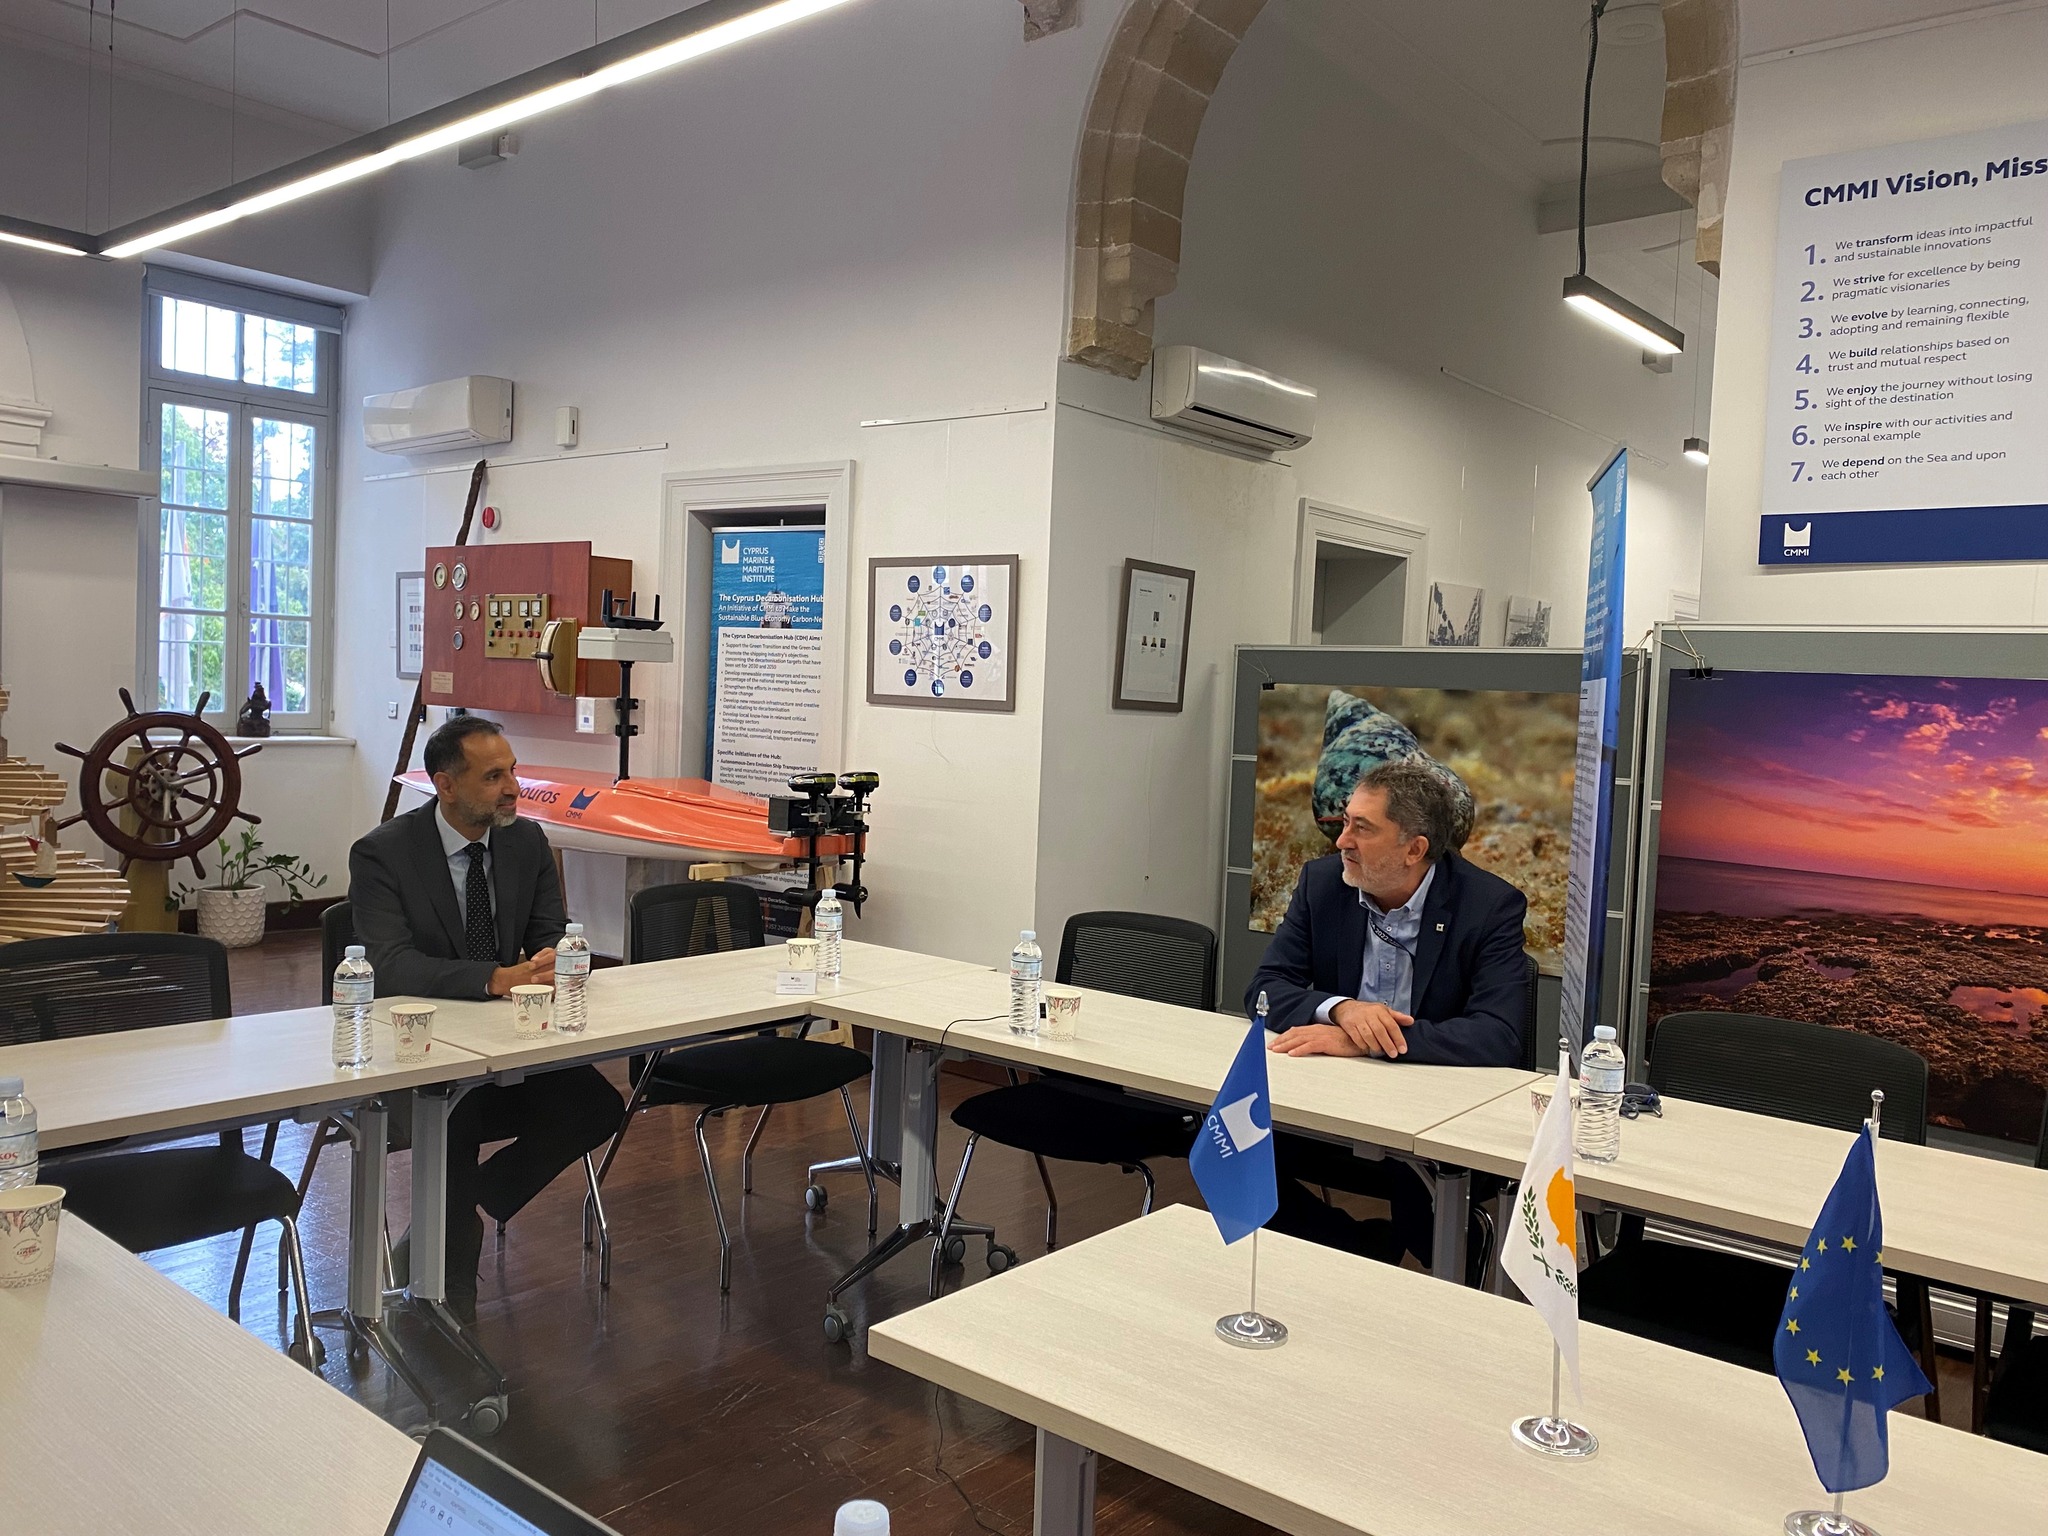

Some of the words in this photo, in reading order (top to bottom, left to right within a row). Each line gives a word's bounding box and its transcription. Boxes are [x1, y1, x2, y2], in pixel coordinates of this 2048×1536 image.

[1804, 179, 1878, 207] CMMI
[1886, 169, 1978, 195] Vision,
[1985, 156, 2048, 182] Miss
[1836, 241, 1853, 250] We
[1856, 233, 1913, 248] transform
[1916, 228, 1946, 240] ideas
[1949, 225, 1972, 236] into
[1975, 216, 2033, 233] impactful
[1804, 244, 1826, 265] 1.
[1834, 252, 1854, 262] and
[1858, 244, 1920, 260] sustainable
[1924, 236, 1991, 251] innovations
[1833, 277, 1850, 286] We
[1853, 273, 1885, 285] strive
[1888, 271, 1904, 281] for
[1907, 263, 1967, 279] excellence
[1970, 260, 1984, 273] by
[1987, 257, 2021, 271] being
[1800, 281, 1824, 302] 2.
[1832, 286, 1887, 300] pragmatic
[1891, 278, 1950, 292] visionaries
[1831, 314, 1848, 324] We
[1851, 310, 1888, 322] evolve
[1891, 308, 1904, 319] by
[1908, 302, 1957, 316] learning,
[1959, 295, 2029, 311] connecting,
[1798, 317, 1821, 338] 3.
[1830, 323, 1878, 337] adopting
[1881, 320, 1902, 331] and
[1906, 314, 1963, 328] remaining
[1966, 310, 2009, 322] flexible
[1829, 350, 1846, 360] We
[1850, 348, 1877, 358] build
[1880, 340, 1953, 356] relationships
[1956, 336, 1991, 348] based
[1995, 336, 2009, 344] on
[1796, 354, 1819, 374] 4.
[1828, 362, 1854, 372] trust
[1857, 359, 1877, 370] and
[1880, 356, 1921, 368] mutual
[1924, 352, 1967, 366] respect
[1827, 387, 1844, 396] We
[1847, 384, 1877, 398] enjoy
[1880, 382, 1899, 392] the
[1900, 379, 1944, 392] journey
[1947, 374, 1993, 386] without
[1997, 372, 2032, 386] losing
[1795, 389, 1817, 410] 5.
[1825, 399, 1852, 410] sight
[1855, 396, 1866, 406] of
[1869, 395, 1887, 405] the
[1890, 391, 1953, 403] destination
[1824, 423, 1841, 432] We
[1844, 420, 1882, 433] inspire
[1885, 419, 1909, 428] with
[1913, 418, 1932, 427] our
[1935, 413, 1987, 425] activities
[1990, 411, 2012, 421] and
[1792, 425, 1815, 445] 6.
[1823, 433, 1870, 446] personal
[1873, 430, 1921, 442] example
[1822, 459, 1839, 468] We
[1842, 456, 1884, 470] depend
[1888, 456, 1902, 464] on
[1905, 454, 1923, 463] the
[1927, 453, 1947, 462] Sea
[1950, 451, 1972, 461] and
[1976, 450, 2006, 462] upon
[1791, 462, 1813, 482] 7.
[1821, 470, 1846, 480] each
[1849, 469, 1879, 479] other
[732, 594, 754, 604] Cyprus
[520, 784, 560, 804] ouros
[1208, 1114, 1233, 1158] CMMI
